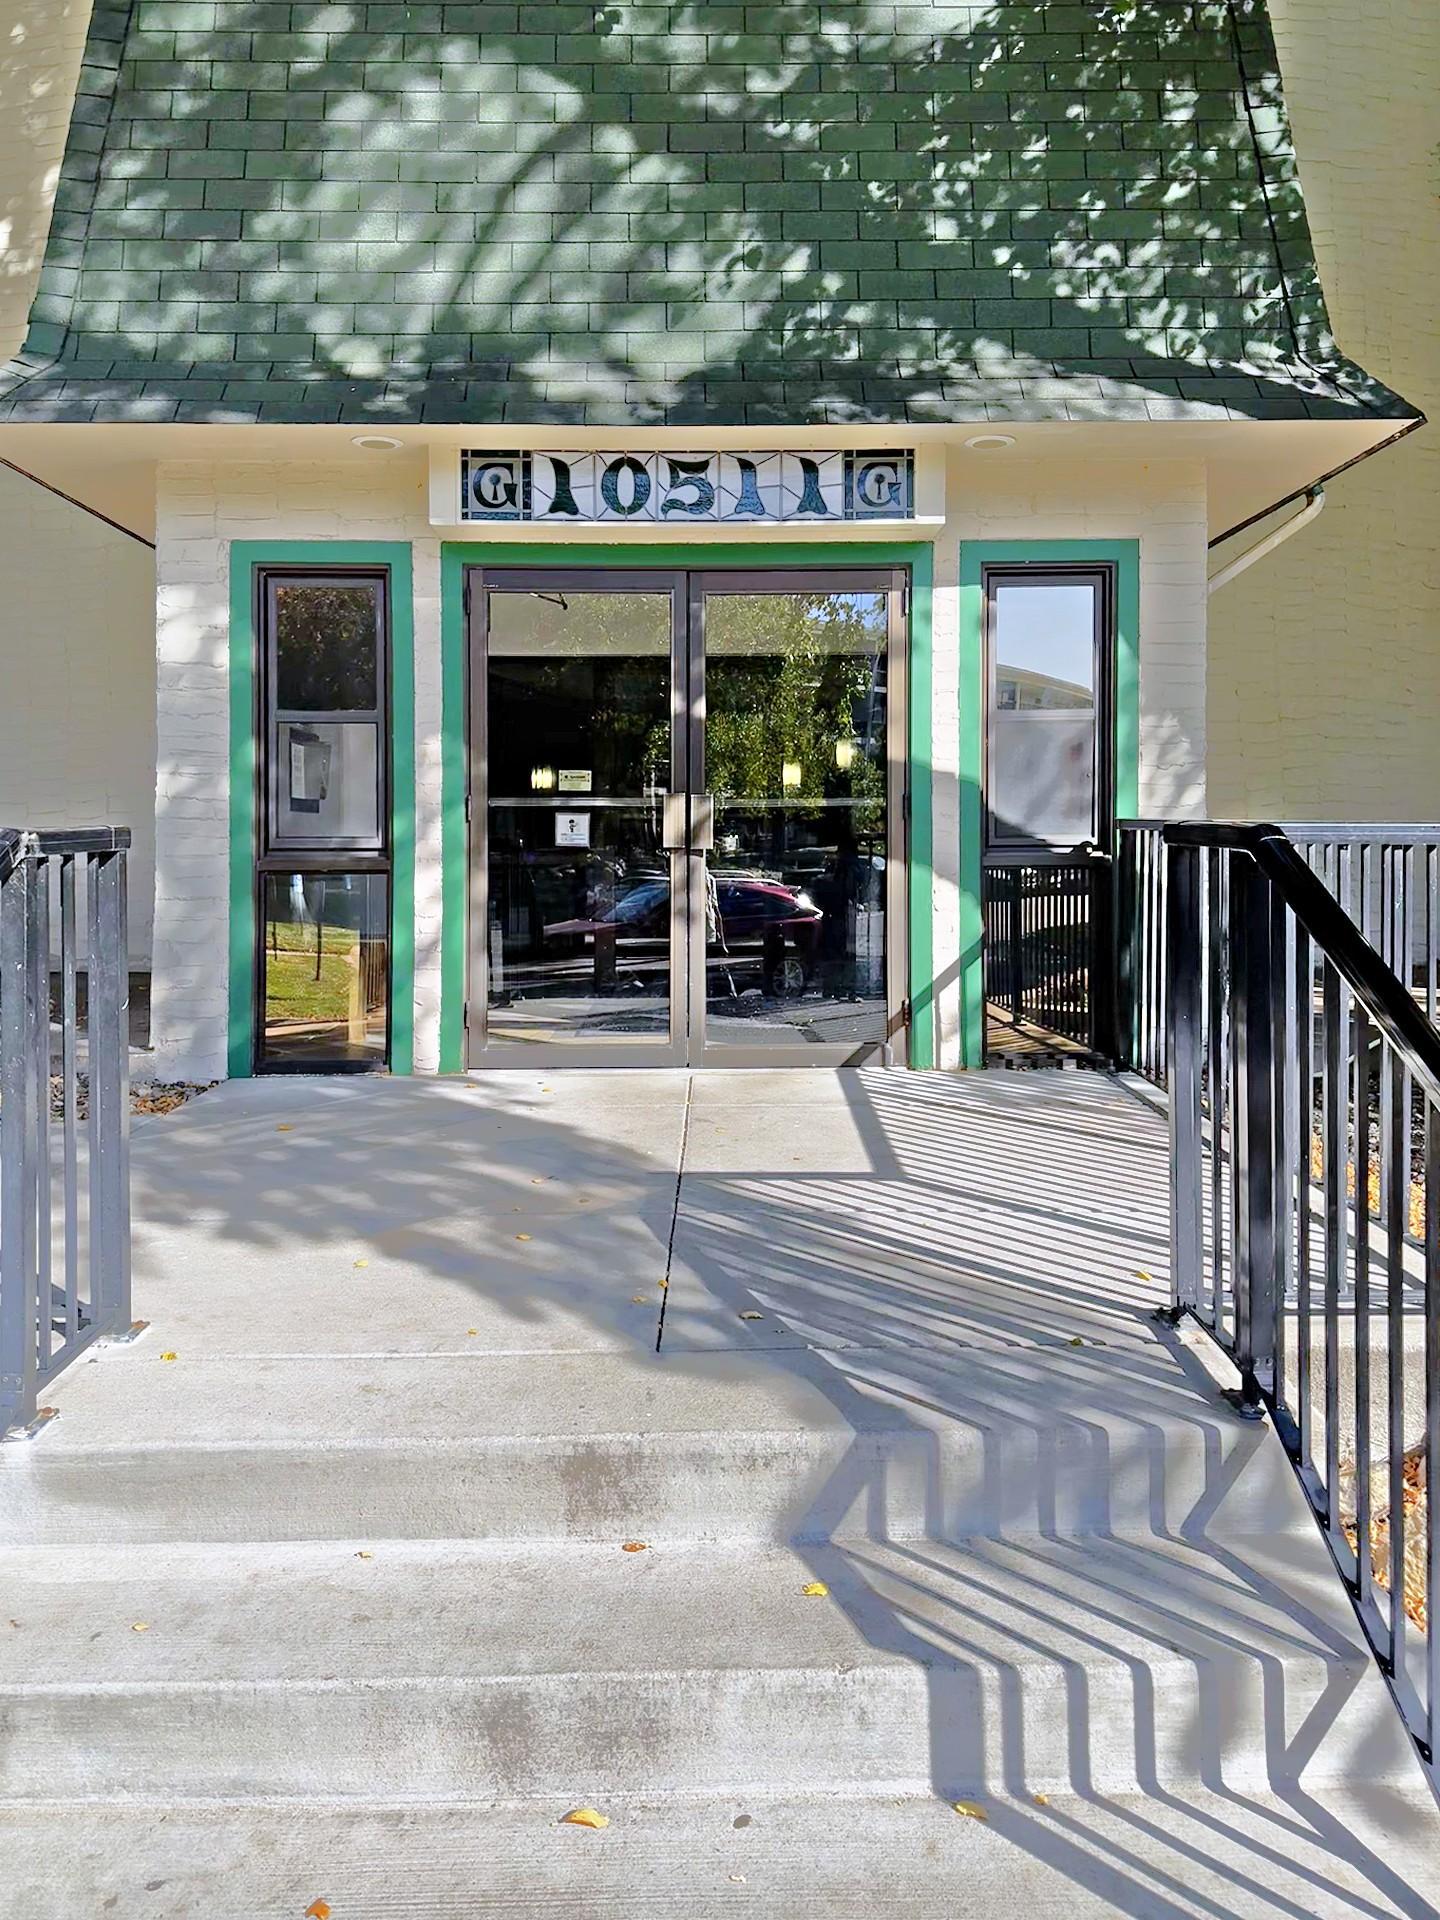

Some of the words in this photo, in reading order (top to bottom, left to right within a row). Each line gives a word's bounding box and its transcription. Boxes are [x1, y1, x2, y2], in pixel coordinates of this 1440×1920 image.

[473, 463, 518, 508] G
[548, 456, 828, 516] 10511
[857, 461, 902, 506] G
